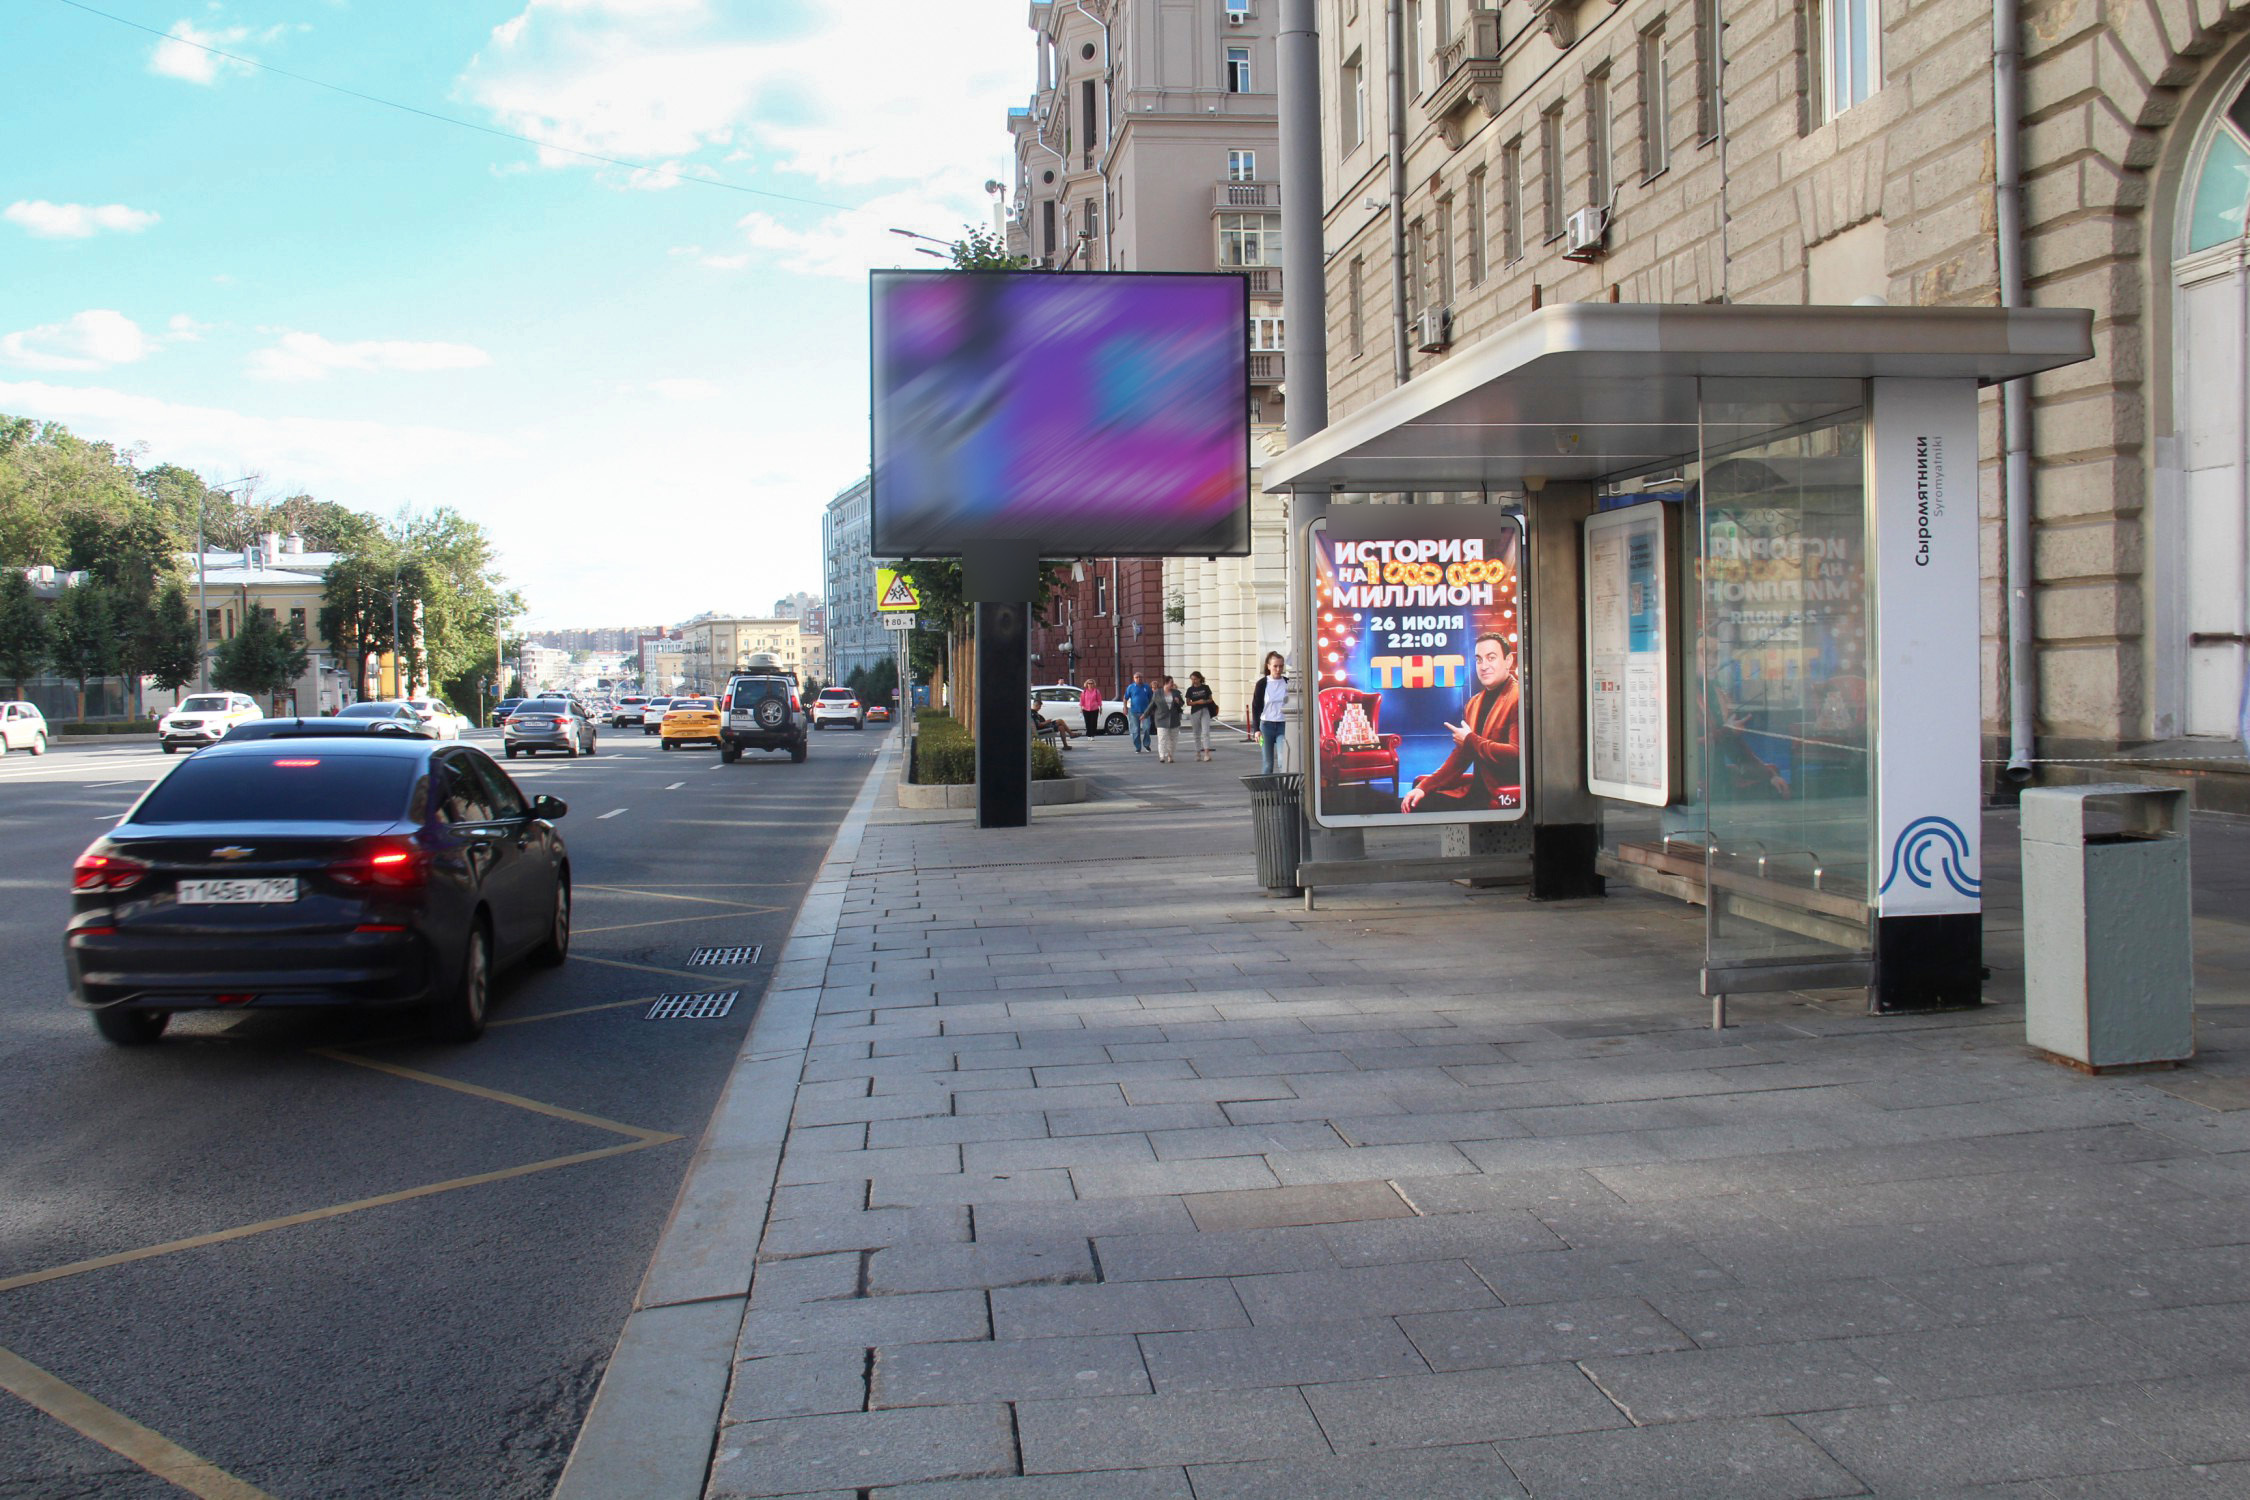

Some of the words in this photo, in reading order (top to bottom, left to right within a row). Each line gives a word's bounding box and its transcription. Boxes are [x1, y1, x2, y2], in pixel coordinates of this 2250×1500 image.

[1932, 436, 1945, 517] Syromyatniki
[1915, 436, 1932, 566] Сыромятники
[1334, 539, 1484, 564] ИСТОРИЯ
[1338, 567, 1368, 583] НА
[1332, 584, 1494, 609] МИЛЛИОН
[1370, 616, 1396, 631] 26
[1402, 615, 1464, 631] ИЮЛЯ
[1387, 632, 1448, 649] 22:00
[1370, 654, 1465, 689] ТНТ
[1498, 794, 1517, 806] 16+
